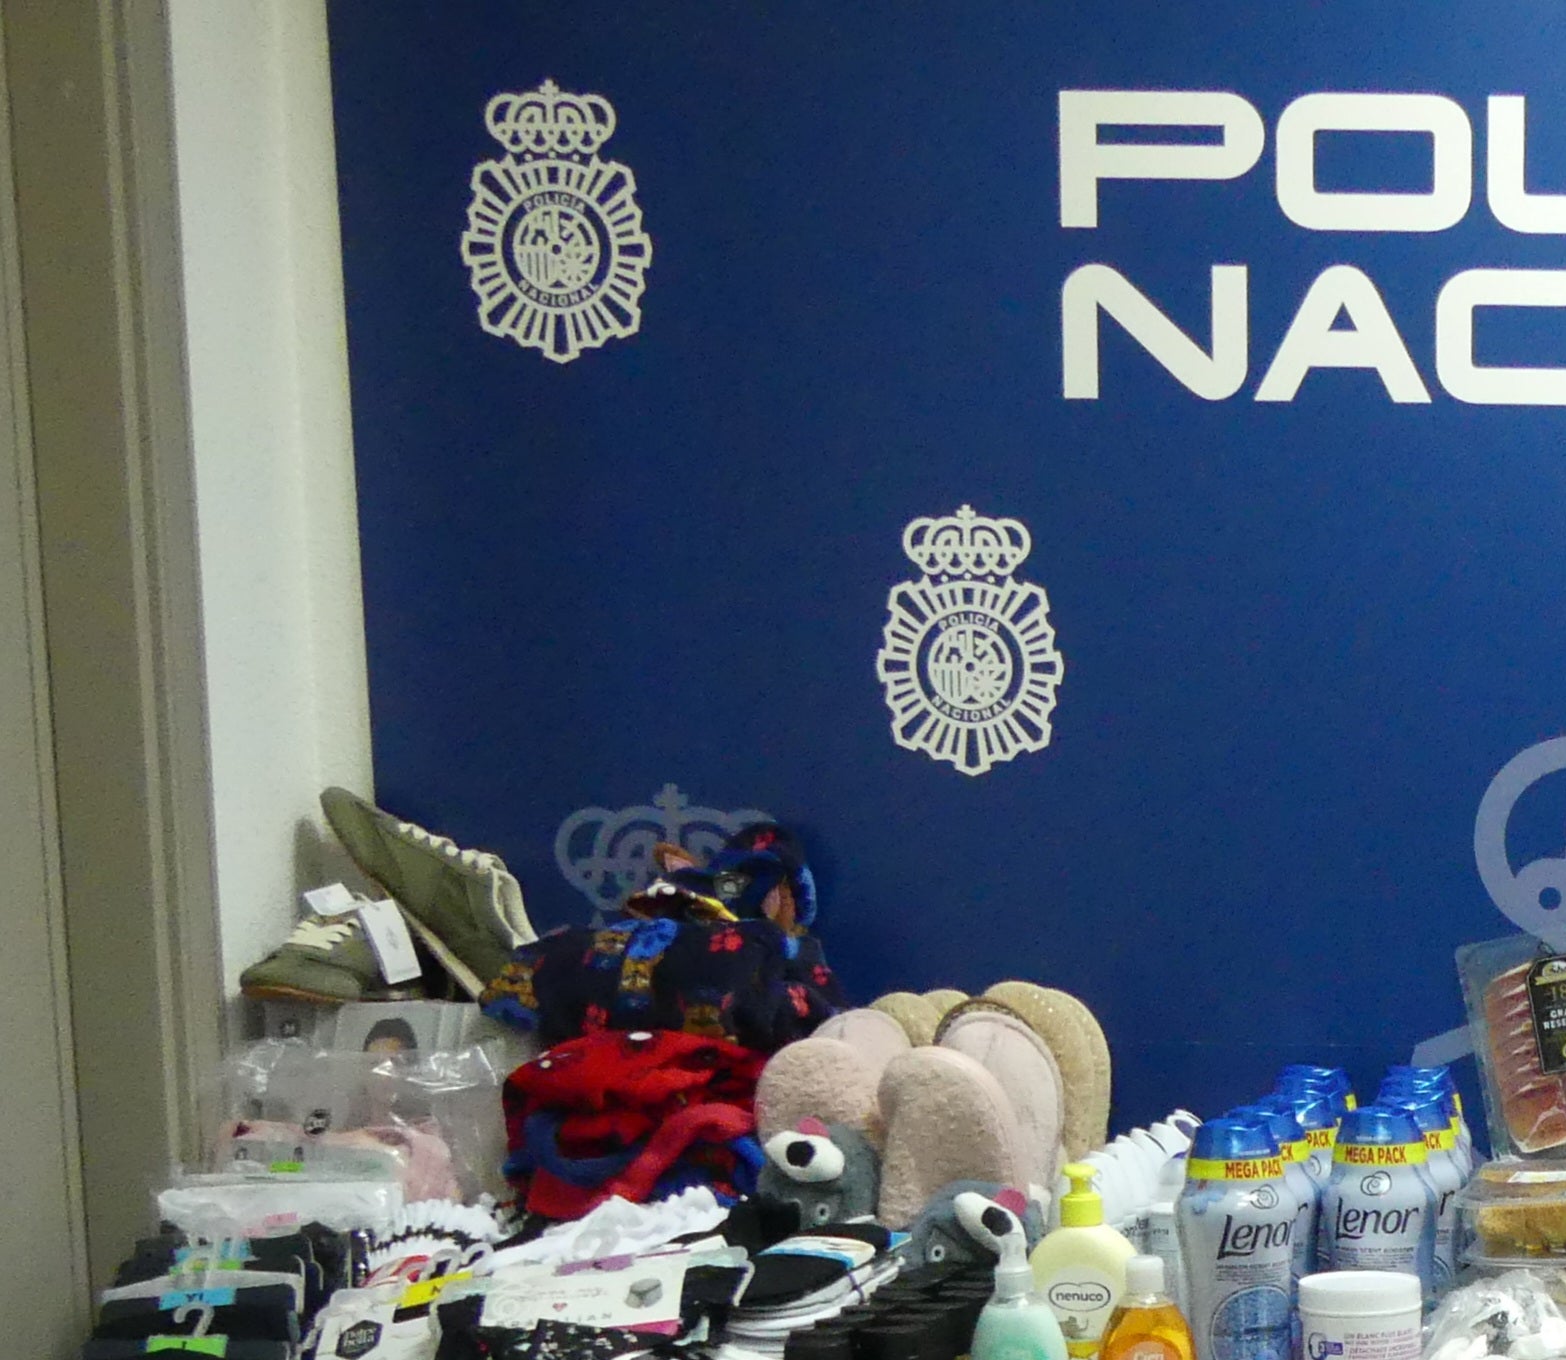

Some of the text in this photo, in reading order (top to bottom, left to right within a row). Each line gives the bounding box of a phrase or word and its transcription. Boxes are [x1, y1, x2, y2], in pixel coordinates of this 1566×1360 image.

[517, 279, 600, 307] NACIONAL
[938, 612, 1001, 633] POLICÍA
[930, 695, 1011, 722] NACIONAL
[1345, 1144, 1407, 1164] MEGA PACK
[1225, 1161, 1259, 1179] MEGA
[1335, 1196, 1419, 1241] Lenor
[1217, 1214, 1297, 1261] Lenor
[1055, 1291, 1104, 1302] nenuco
